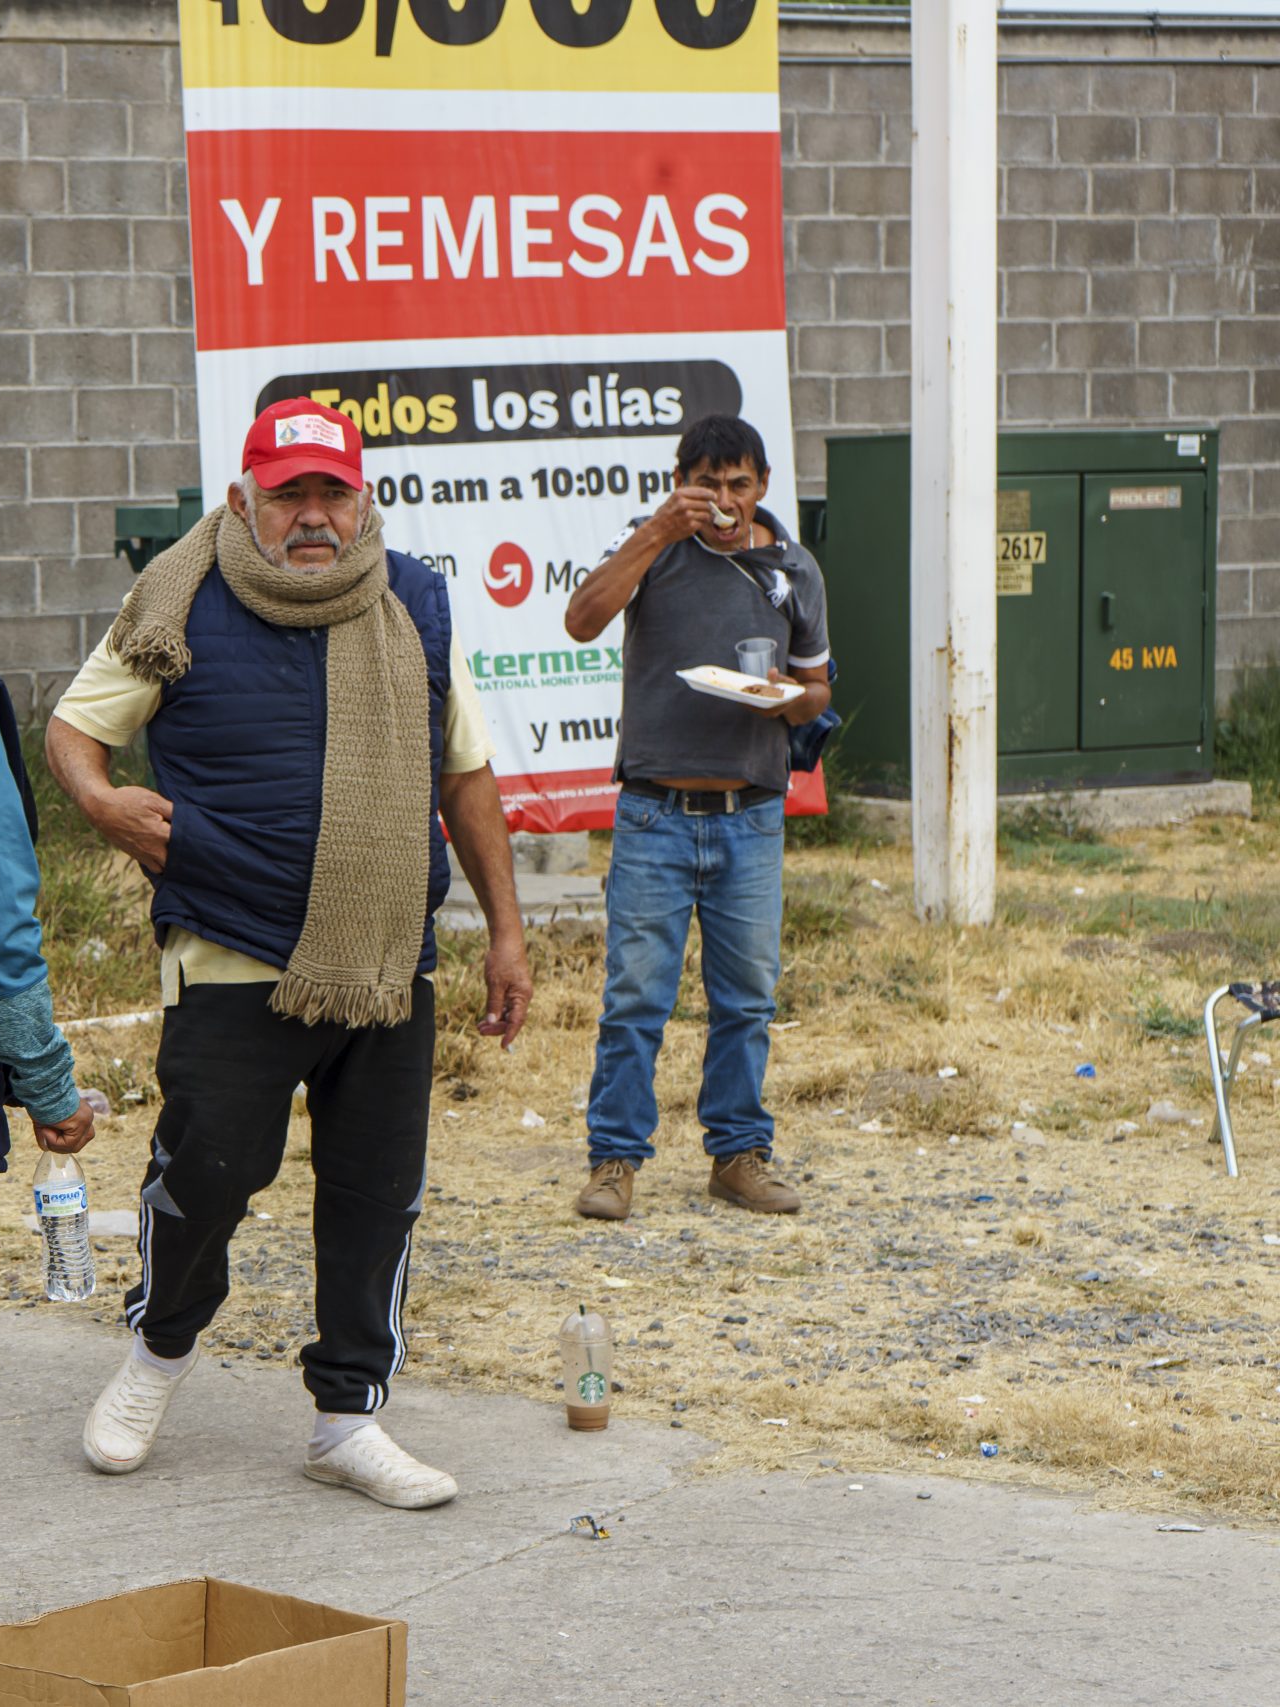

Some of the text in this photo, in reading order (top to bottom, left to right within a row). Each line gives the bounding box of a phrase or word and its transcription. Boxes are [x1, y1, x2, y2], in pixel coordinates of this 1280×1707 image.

[219, 193, 751, 286] Y REMESAS
[472, 378, 561, 432] los
[570, 372, 684, 428] días
[371, 473, 422, 507] 00
[431, 478, 489, 503] am
[500, 476, 523, 501] a
[531, 464, 629, 499] 10:00
[997, 536, 1044, 561] 2617
[544, 559, 590, 595] Mo
[465, 647, 624, 679] termex
[1109, 645, 1178, 671] 45 kVA
[474, 670, 624, 692] NATIONAL MONEY EXPRE
[529, 720, 549, 754] y
